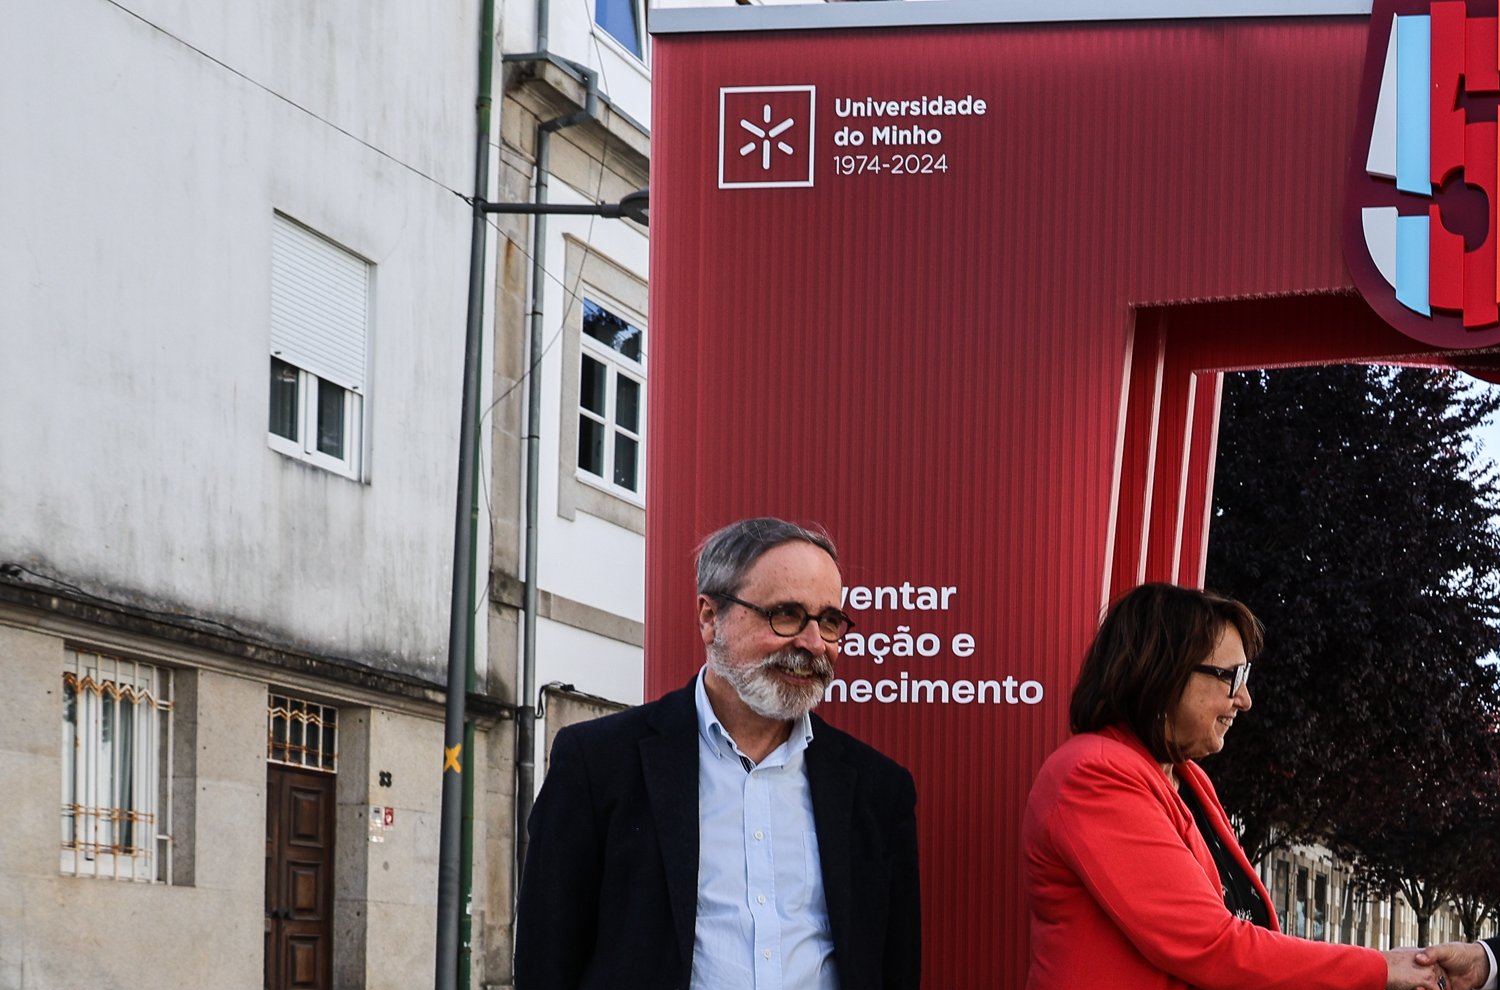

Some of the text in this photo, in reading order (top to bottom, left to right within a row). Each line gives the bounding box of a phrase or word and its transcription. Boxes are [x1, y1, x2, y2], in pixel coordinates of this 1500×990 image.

[835, 95, 987, 117] Universidade
[834, 125, 942, 146] do Minho
[833, 154, 948, 175] 1974-2024
[837, 625, 976, 665] ação e
